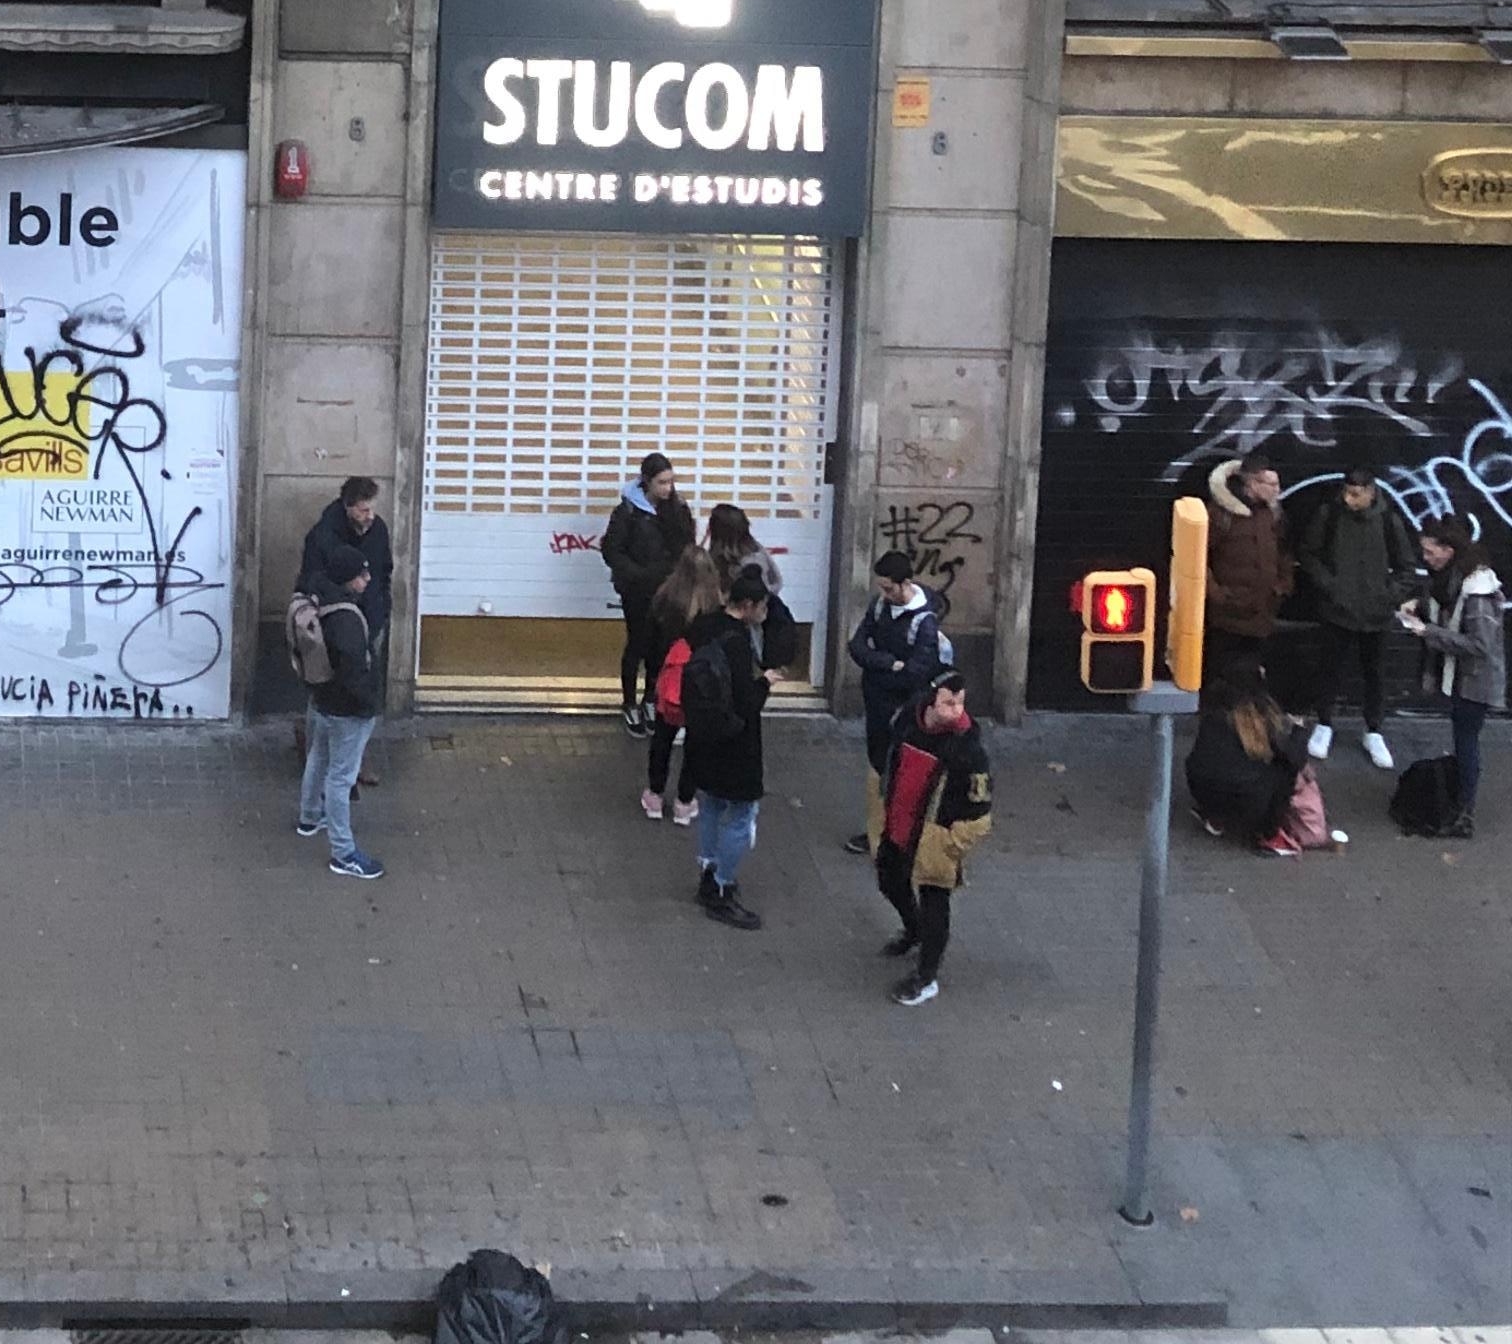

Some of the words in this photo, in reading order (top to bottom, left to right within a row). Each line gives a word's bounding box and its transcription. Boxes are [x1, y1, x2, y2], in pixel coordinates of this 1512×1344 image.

[483, 57, 825, 152] STUCOM
[479, 170, 619, 202] CENTRE
[633, 174, 824, 207] D'ESTUDIS
[40, 490, 133, 506] AGUIRRE
[40, 507, 134, 523] NEWMAN
[879, 501, 983, 550] #22
